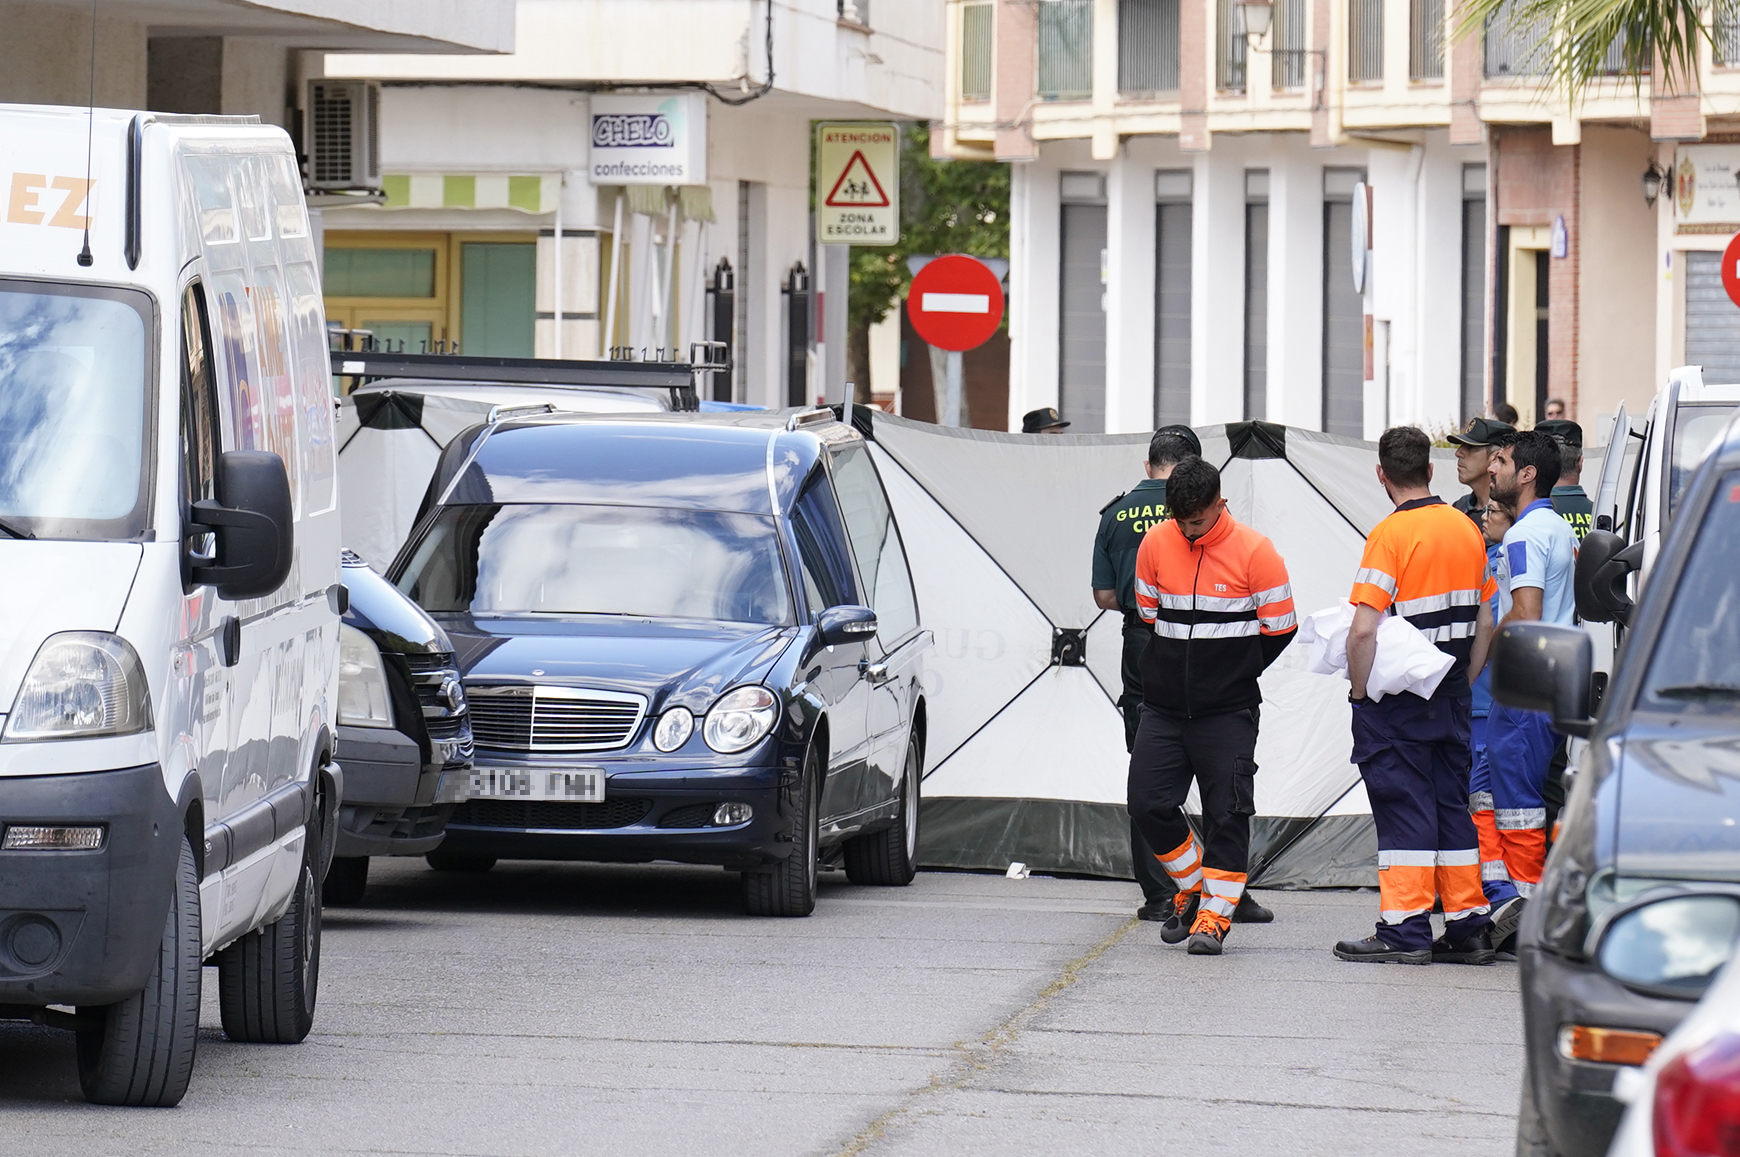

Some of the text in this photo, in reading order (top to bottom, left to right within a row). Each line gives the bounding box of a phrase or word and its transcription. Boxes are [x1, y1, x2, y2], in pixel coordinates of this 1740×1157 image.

[593, 116, 671, 145] CHELO
[826, 133, 891, 143] ATENCION
[594, 160, 683, 176] confecciones
[0, 172, 97, 230] EZ
[840, 213, 874, 223] ZONA
[827, 225, 887, 236] ESCOLAR
[1561, 512, 1592, 525] UAR
[1214, 583, 1227, 592] TES
